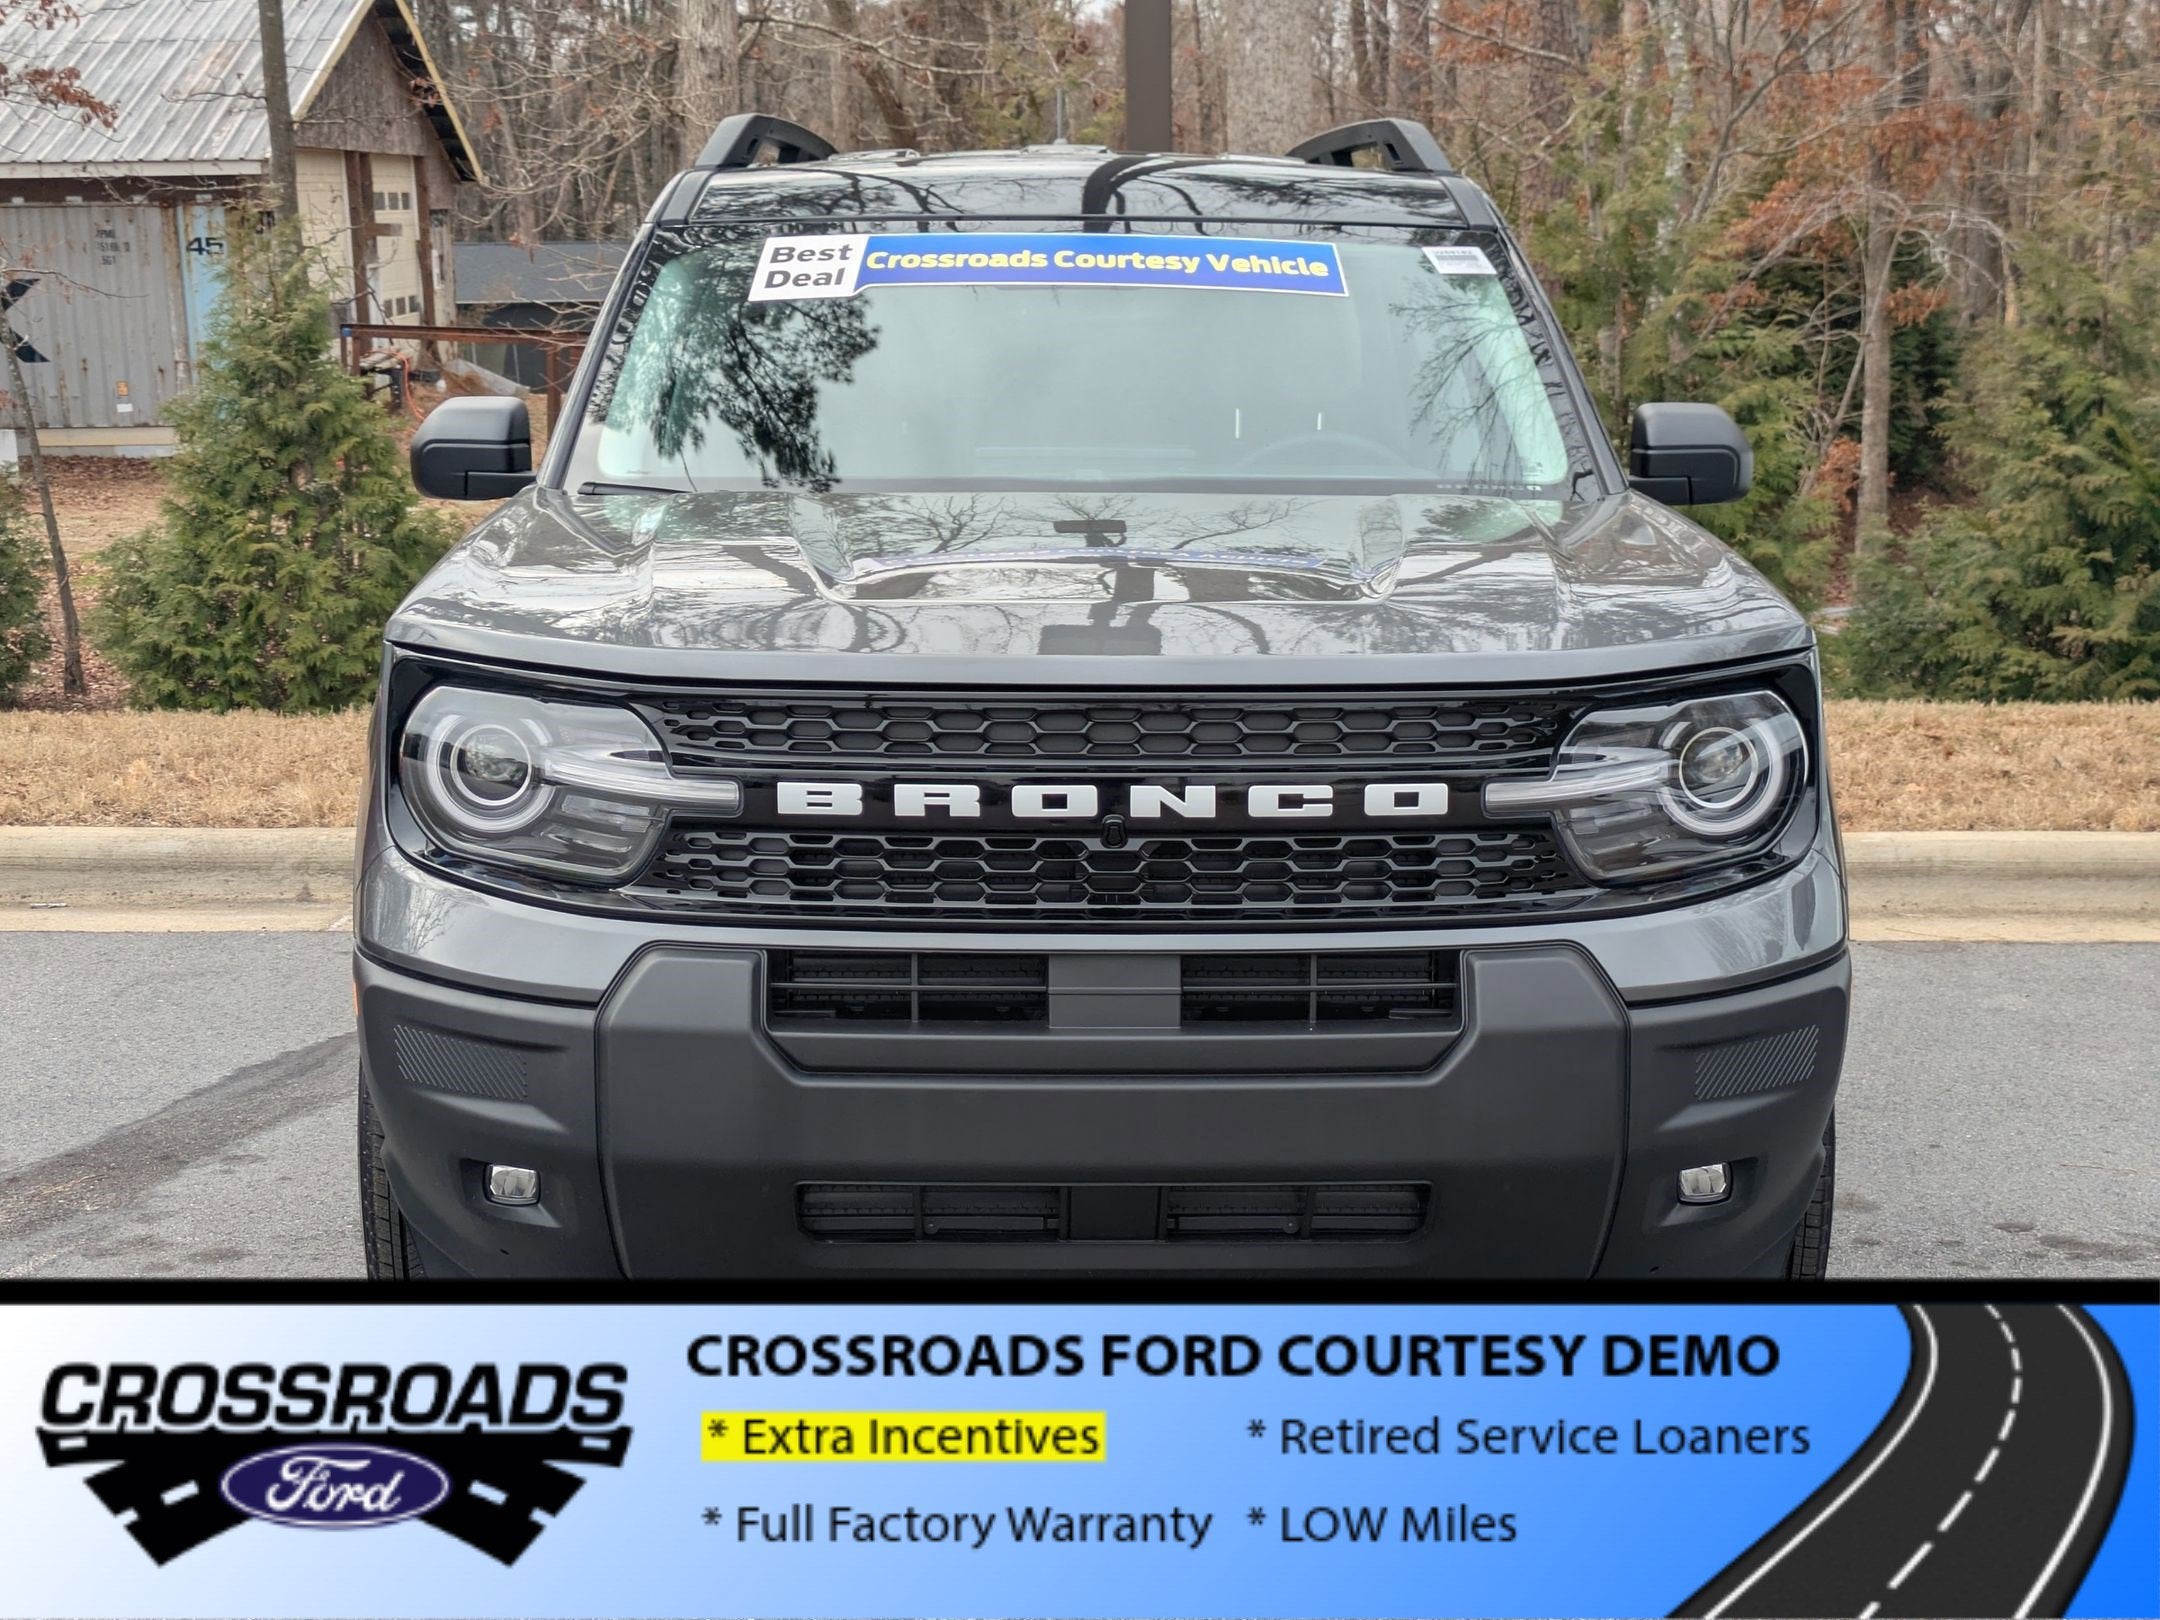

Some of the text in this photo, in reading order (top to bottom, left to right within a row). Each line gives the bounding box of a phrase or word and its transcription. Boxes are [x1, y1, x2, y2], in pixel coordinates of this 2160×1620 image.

[769, 243, 853, 264] Best
[866, 250, 1329, 277] Crossroads Courtesy Vehicle
[764, 267, 846, 289] Deal
[776, 781, 1449, 818] BRONCO
